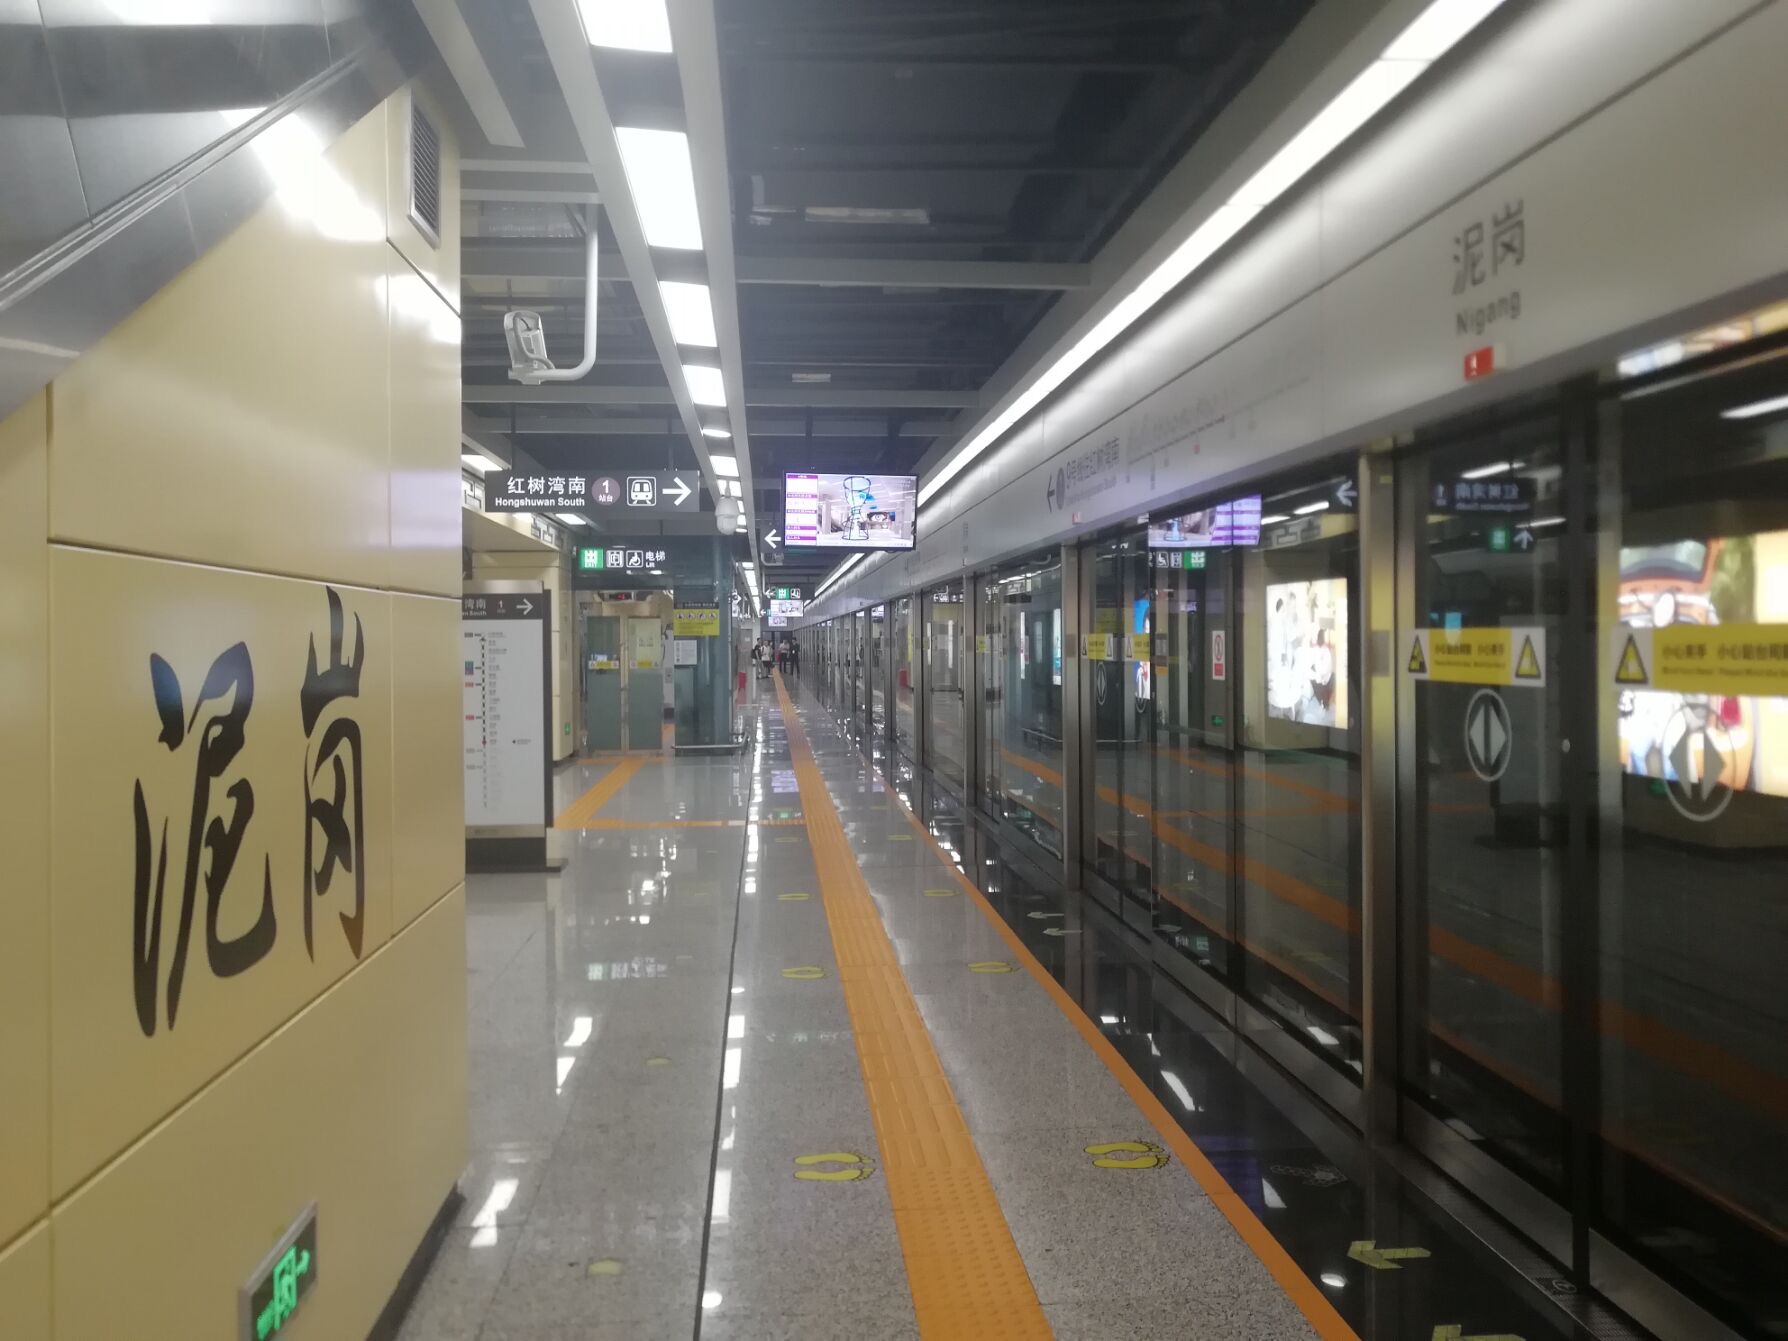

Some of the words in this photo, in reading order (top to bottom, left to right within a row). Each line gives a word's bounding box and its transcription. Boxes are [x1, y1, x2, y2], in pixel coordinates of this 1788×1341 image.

[1452, 197, 1525, 295] 泥岗
[1456, 291, 1521, 336] Nigang
[507, 476, 586, 495] 红树湾南
[602, 479, 610, 493] 1
[495, 497, 555, 508] Hongshuwan
[557, 497, 585, 506] South
[645, 551, 665, 562] 电梯
[133, 584, 365, 1038] 泥岗
